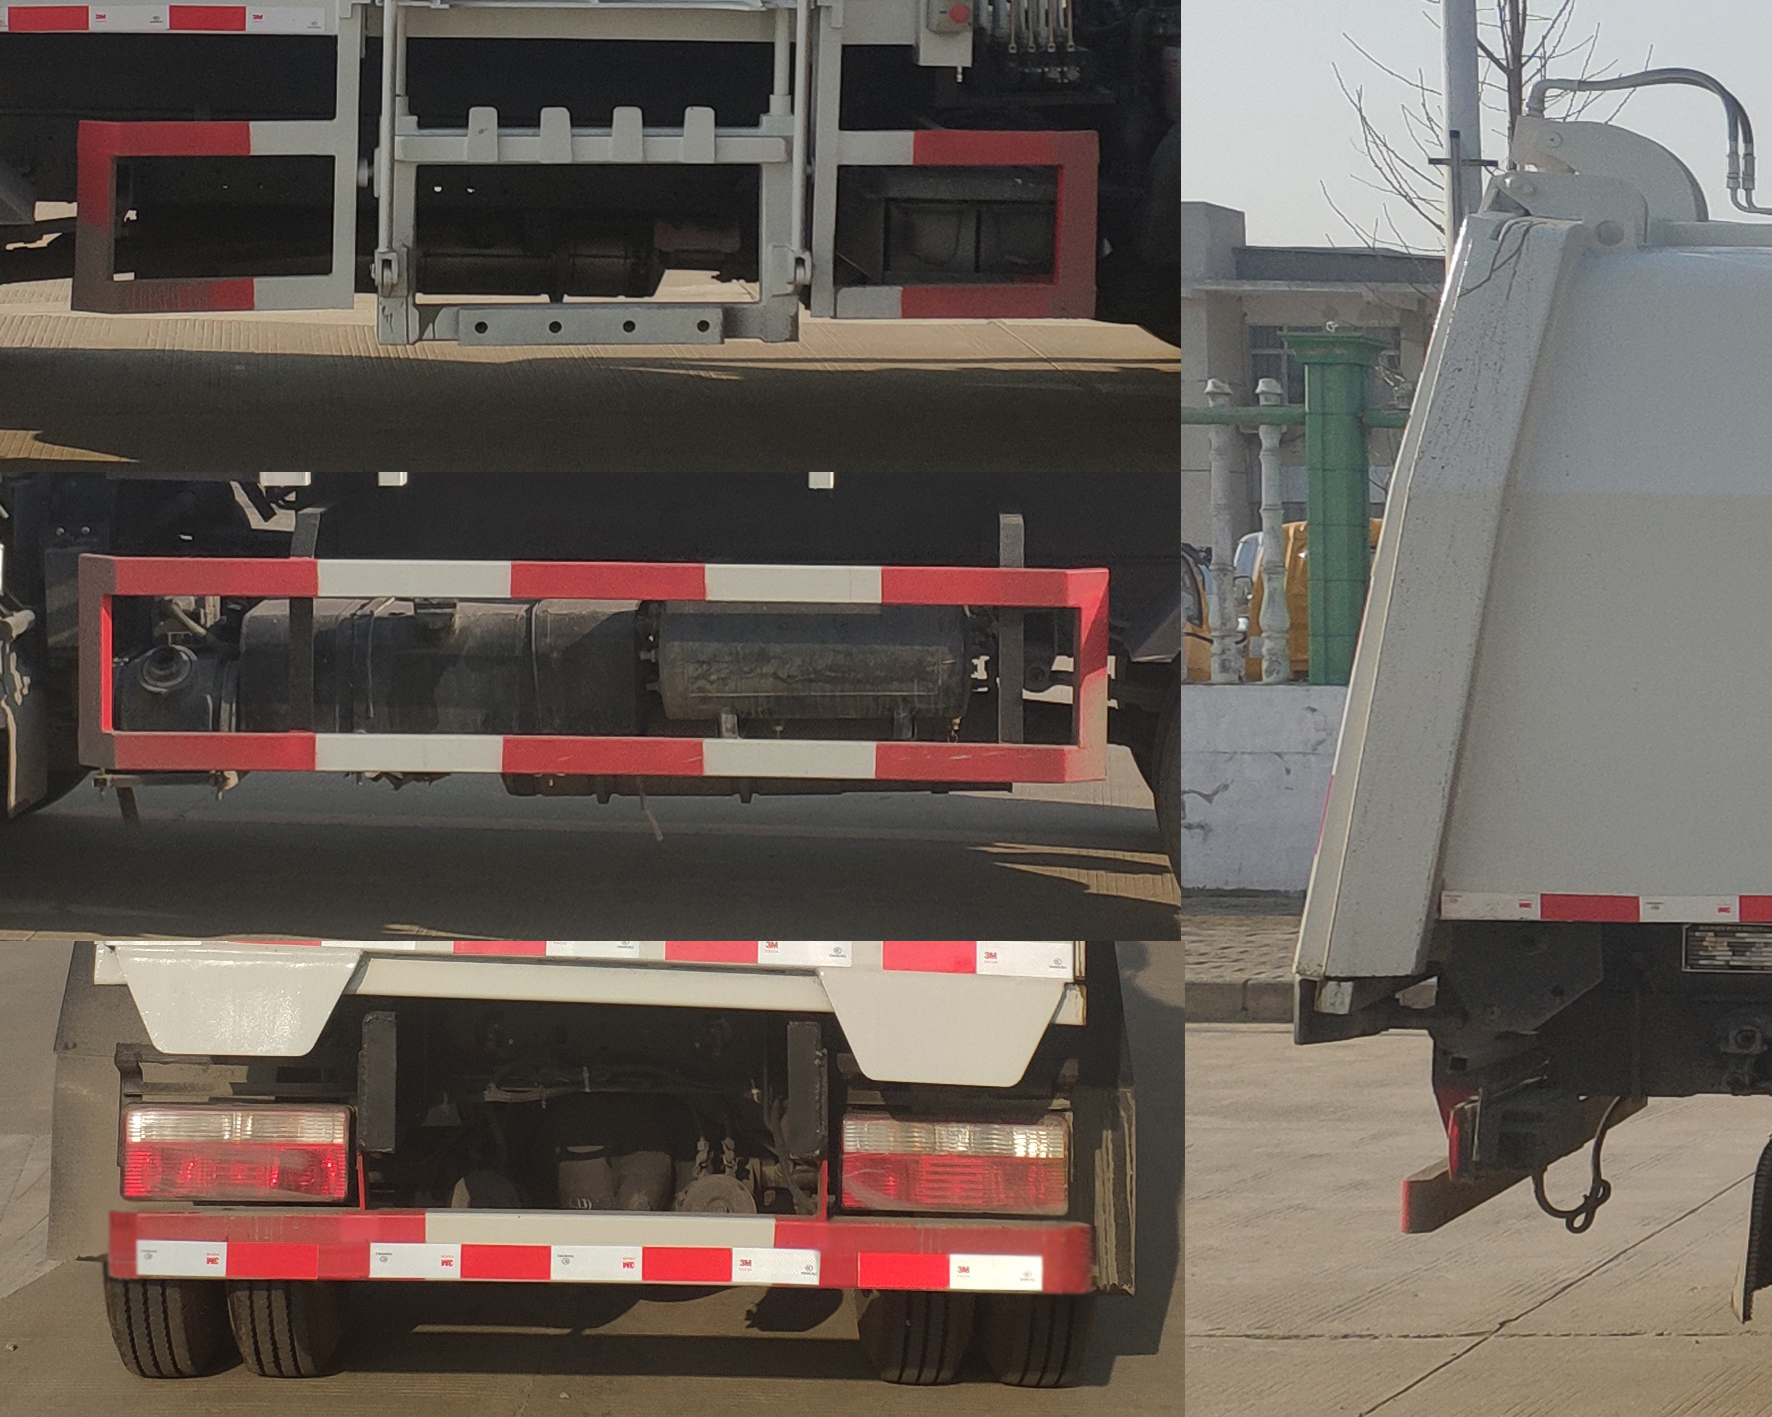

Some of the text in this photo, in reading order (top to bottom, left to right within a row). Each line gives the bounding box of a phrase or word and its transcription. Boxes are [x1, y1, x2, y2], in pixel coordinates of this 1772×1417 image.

[765, 941, 778, 949] 3M
[984, 951, 997, 959] 3M
[740, 1259, 752, 1267] 3M
[957, 1265, 970, 1274] 3M
